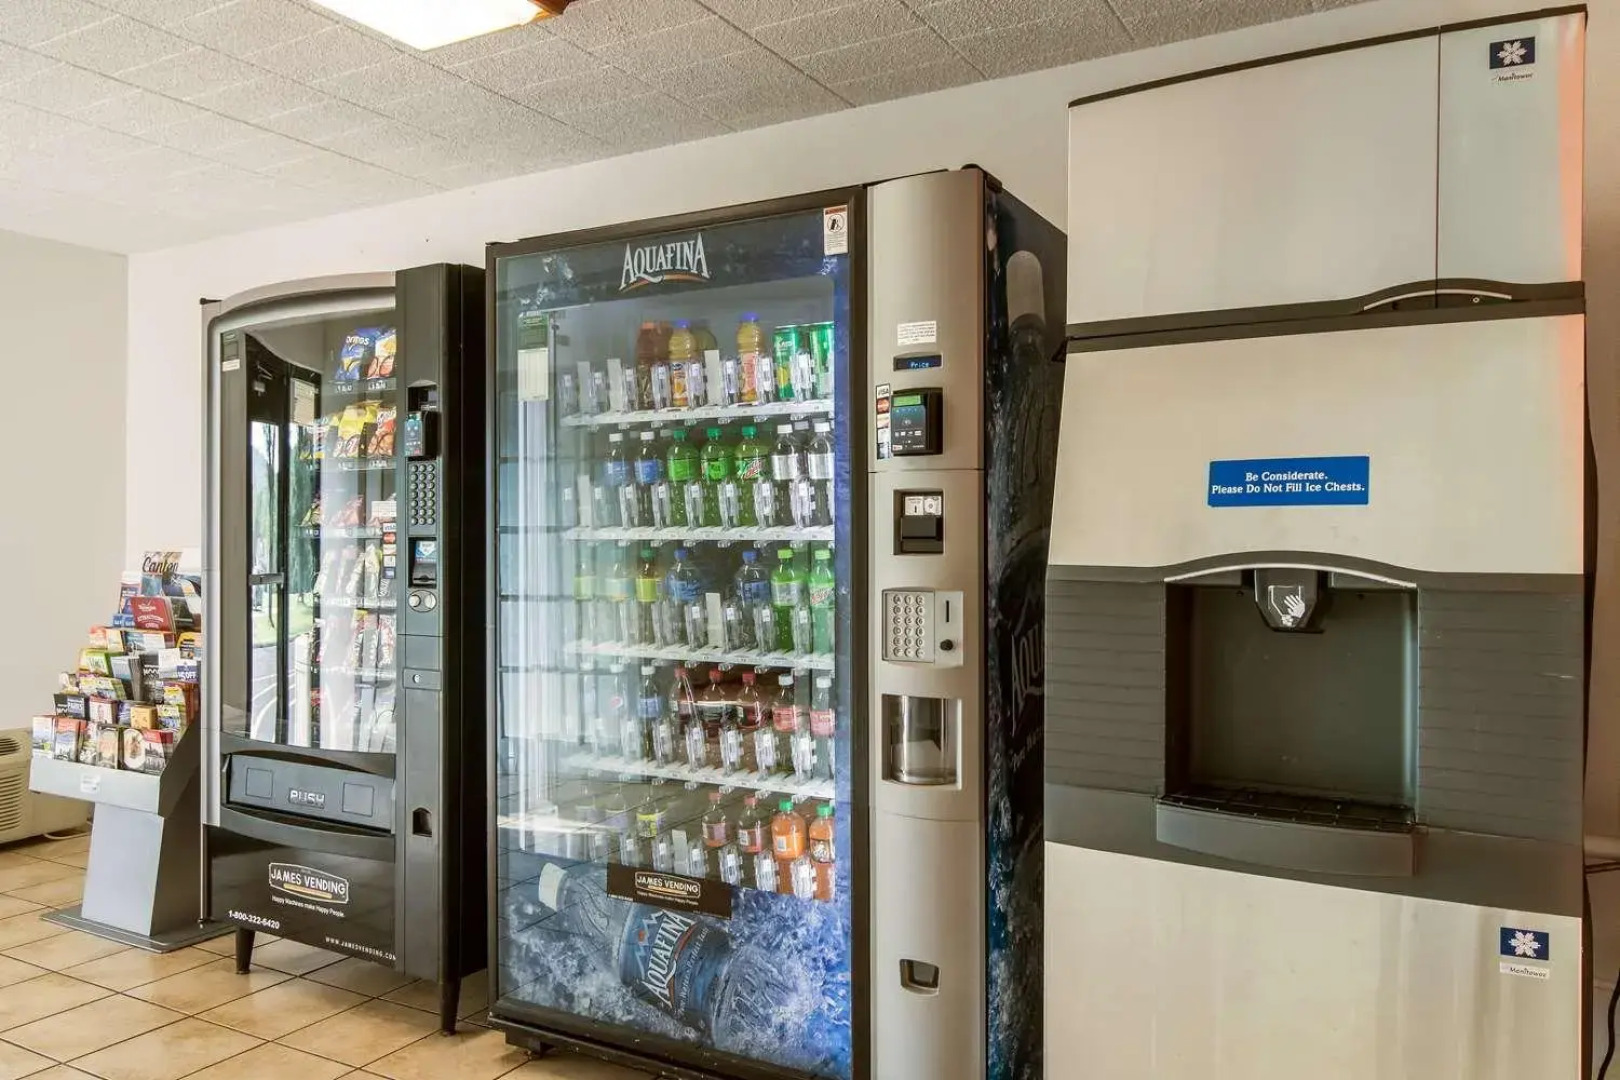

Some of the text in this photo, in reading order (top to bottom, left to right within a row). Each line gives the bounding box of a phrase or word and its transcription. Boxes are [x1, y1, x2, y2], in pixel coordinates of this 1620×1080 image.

[619, 232, 709, 290] AQUAFINA
[1245, 471, 1328, 482] Be Considerate.
[1211, 482, 1365, 495] Please Do Not Fill Ice Chests.
[290, 789, 325, 803] PUSH
[271, 868, 346, 895] JAMES VENDING
[637, 876, 698, 893] JAMES VENDING
[228, 909, 280, 930] 1-800-322-6420
[641, 908, 695, 1008] AQUAFINA
